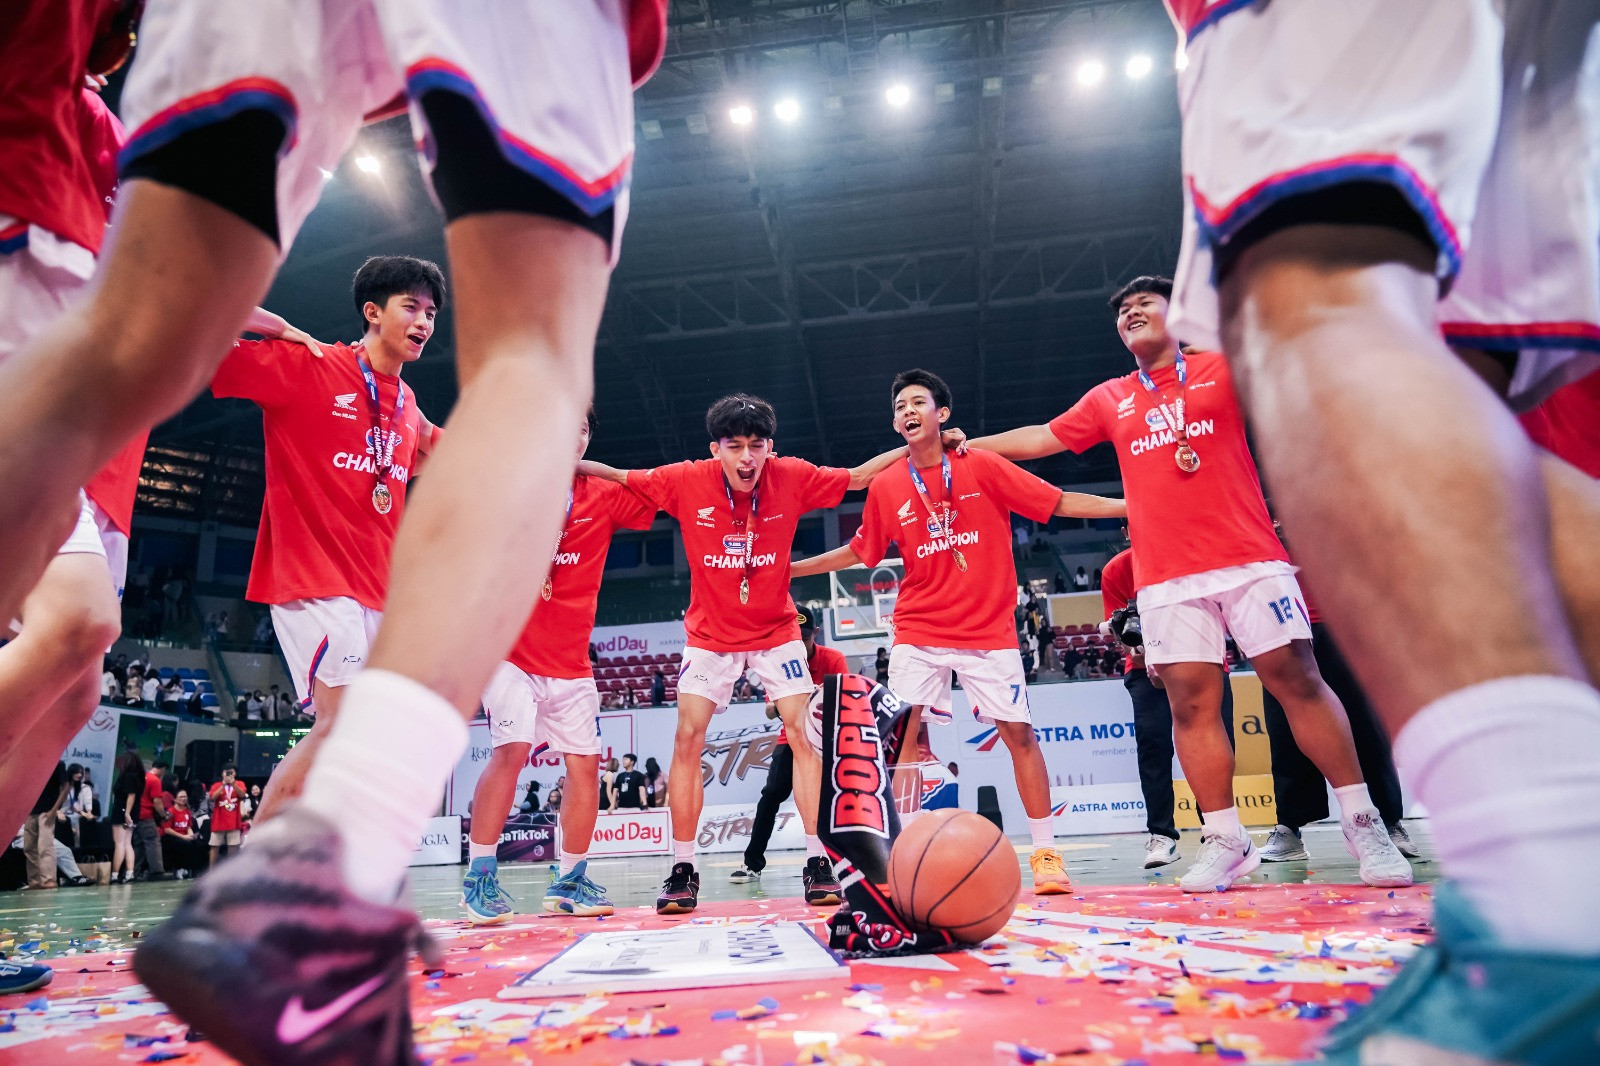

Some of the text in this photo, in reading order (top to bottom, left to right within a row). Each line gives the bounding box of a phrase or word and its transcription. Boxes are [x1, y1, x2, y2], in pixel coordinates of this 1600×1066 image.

[374, 426, 383, 465] CHAMPION
[384, 430, 397, 466] CHAMPION
[1130, 419, 1214, 456] CHAMION
[916, 530, 979, 558] CHAMPION
[703, 552, 777, 568] CHAMION
[1268, 595, 1294, 625] 12
[591, 636, 648, 654] ood Day
[781, 659, 804, 680] 10
[876, 690, 907, 719] 19
[1009, 684, 1021, 704] 7
[1033, 722, 1135, 743] STRA MOT
[701, 734, 779, 788] STR
[1129, 746, 1137, 756] o
[1072, 801, 1145, 813] ASTRA MOTO
[415, 833, 450, 846] OGJA
[593, 822, 663, 843] ood Day
